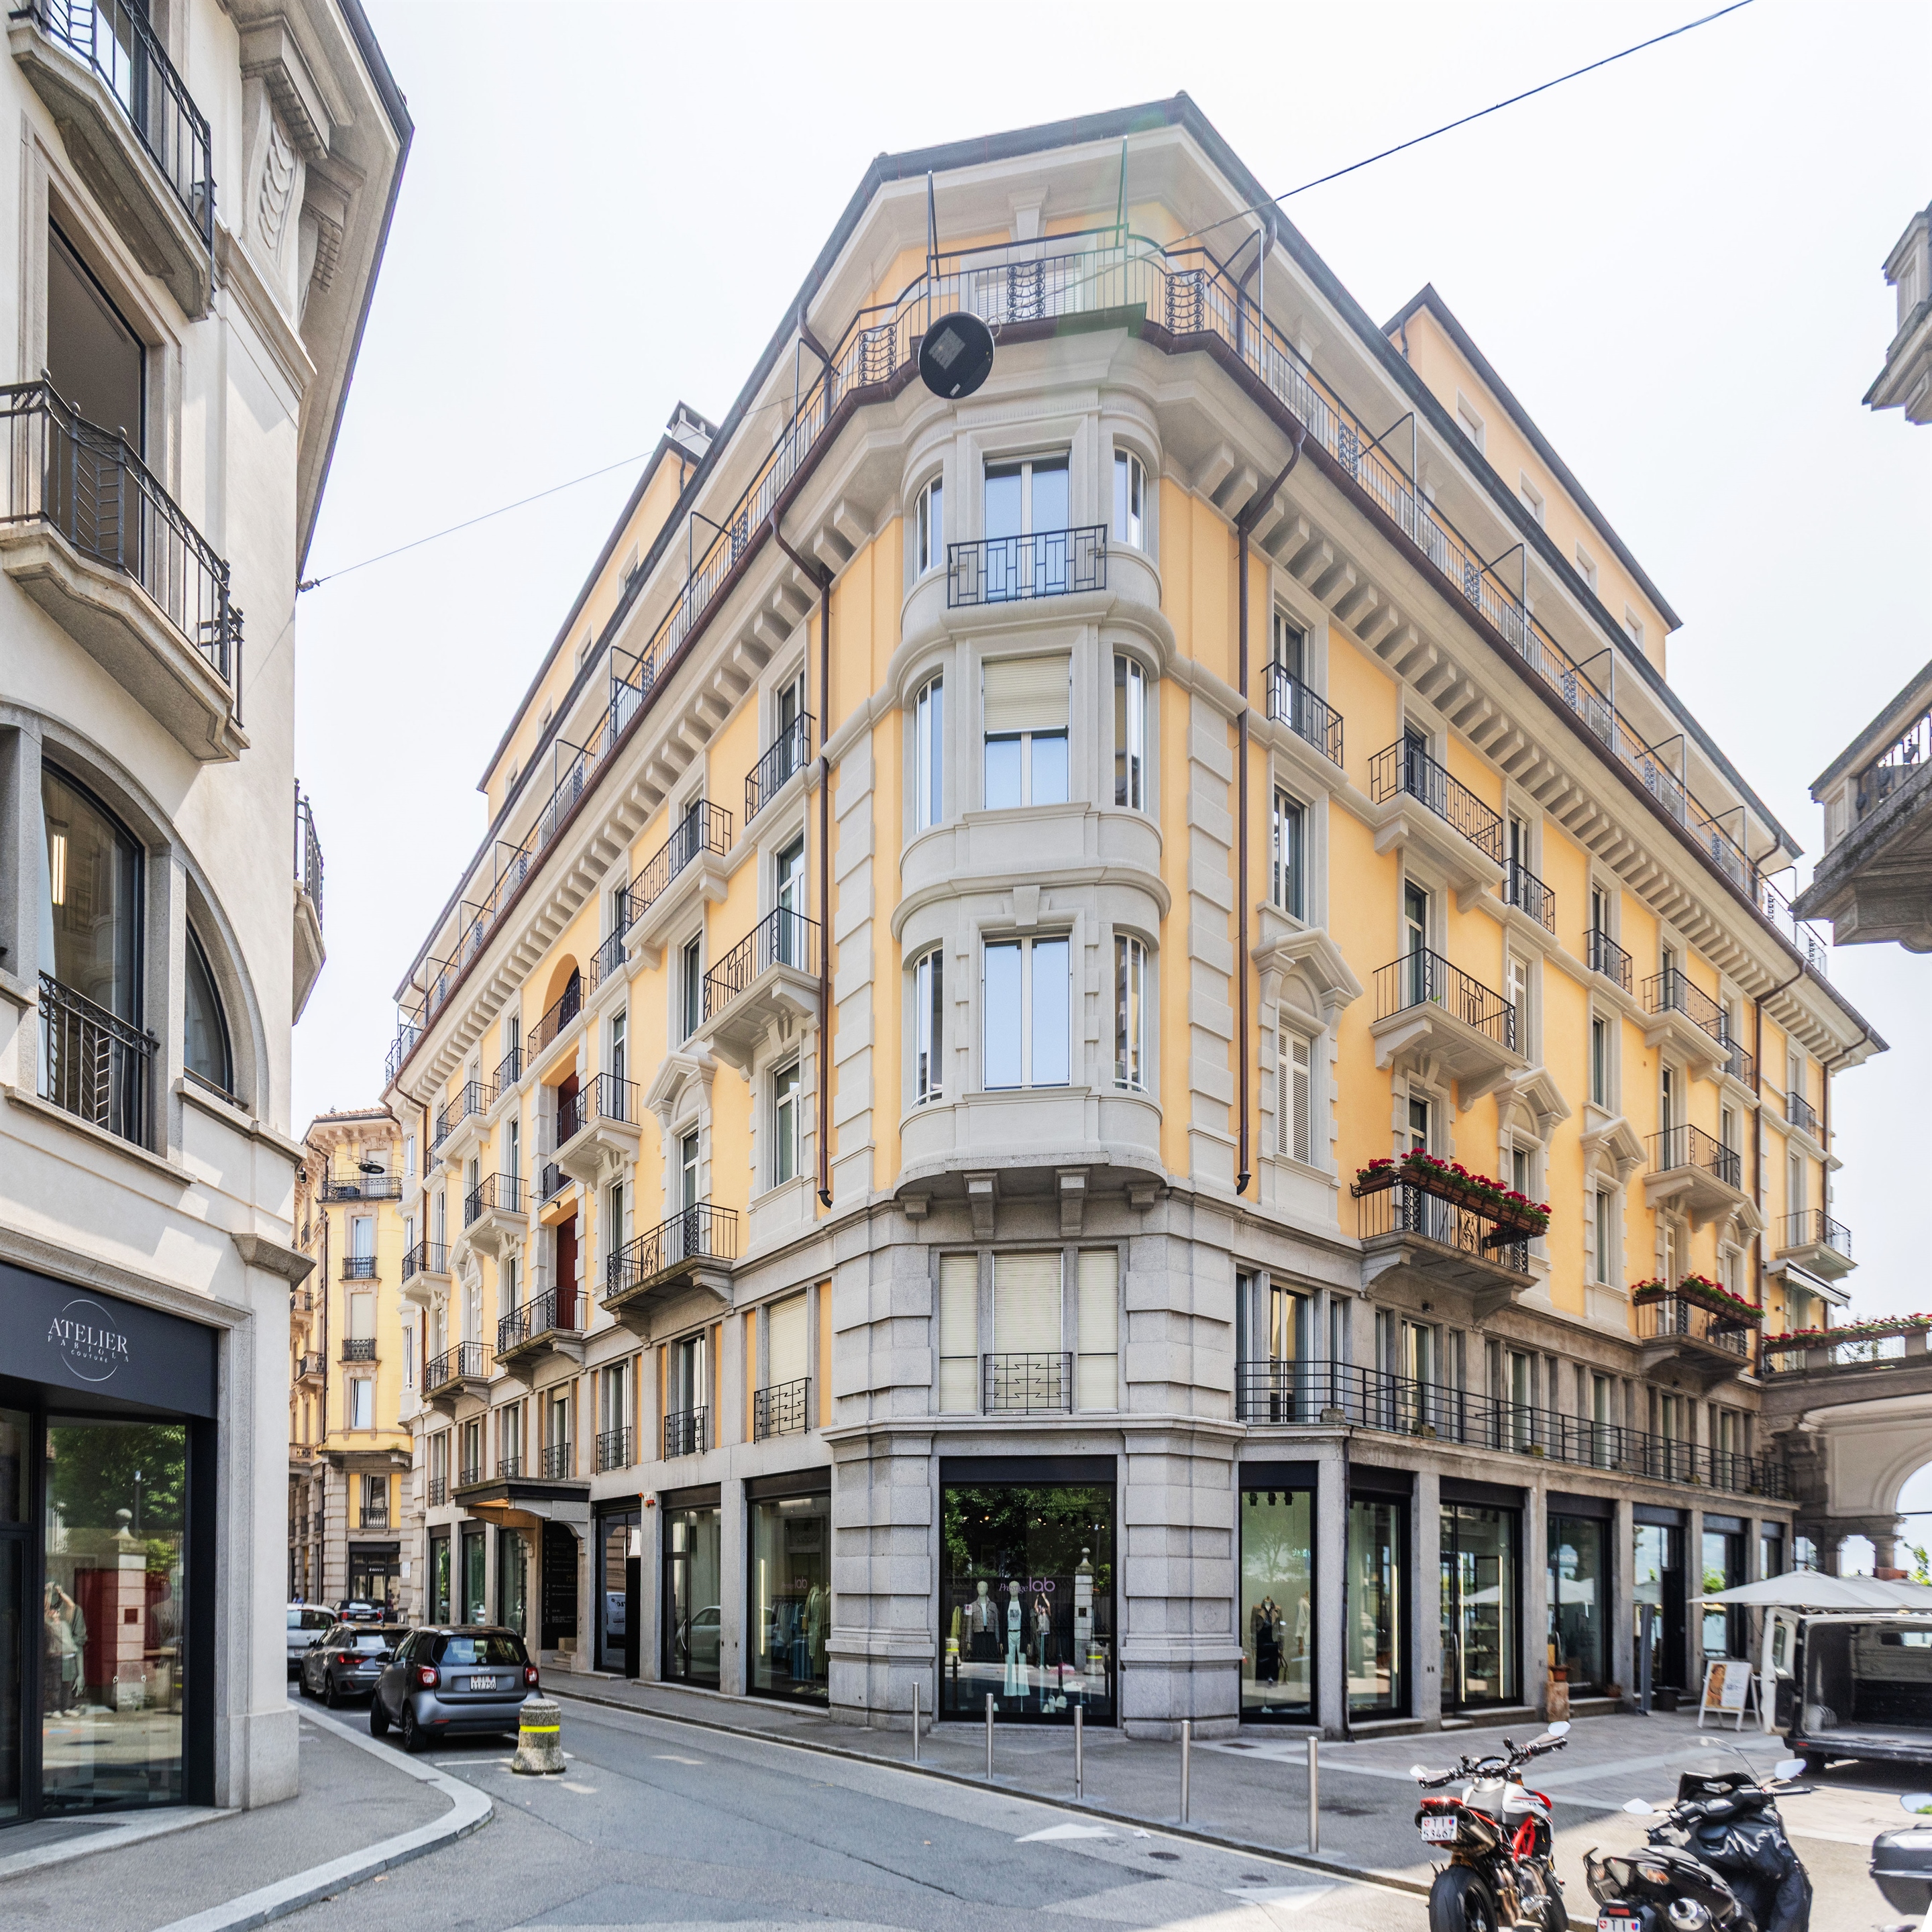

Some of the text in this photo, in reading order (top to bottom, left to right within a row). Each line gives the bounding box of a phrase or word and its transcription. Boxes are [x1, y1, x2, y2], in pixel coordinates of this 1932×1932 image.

[48, 1317, 128, 1354] ATELIER
[47, 1334, 129, 1362] FABIOLA
[70, 1349, 108, 1363] COUTURE
[794, 1576, 808, 1589] lab
[1029, 1576, 1056, 1593] lab
[1423, 1827, 1454, 1840] 53467
